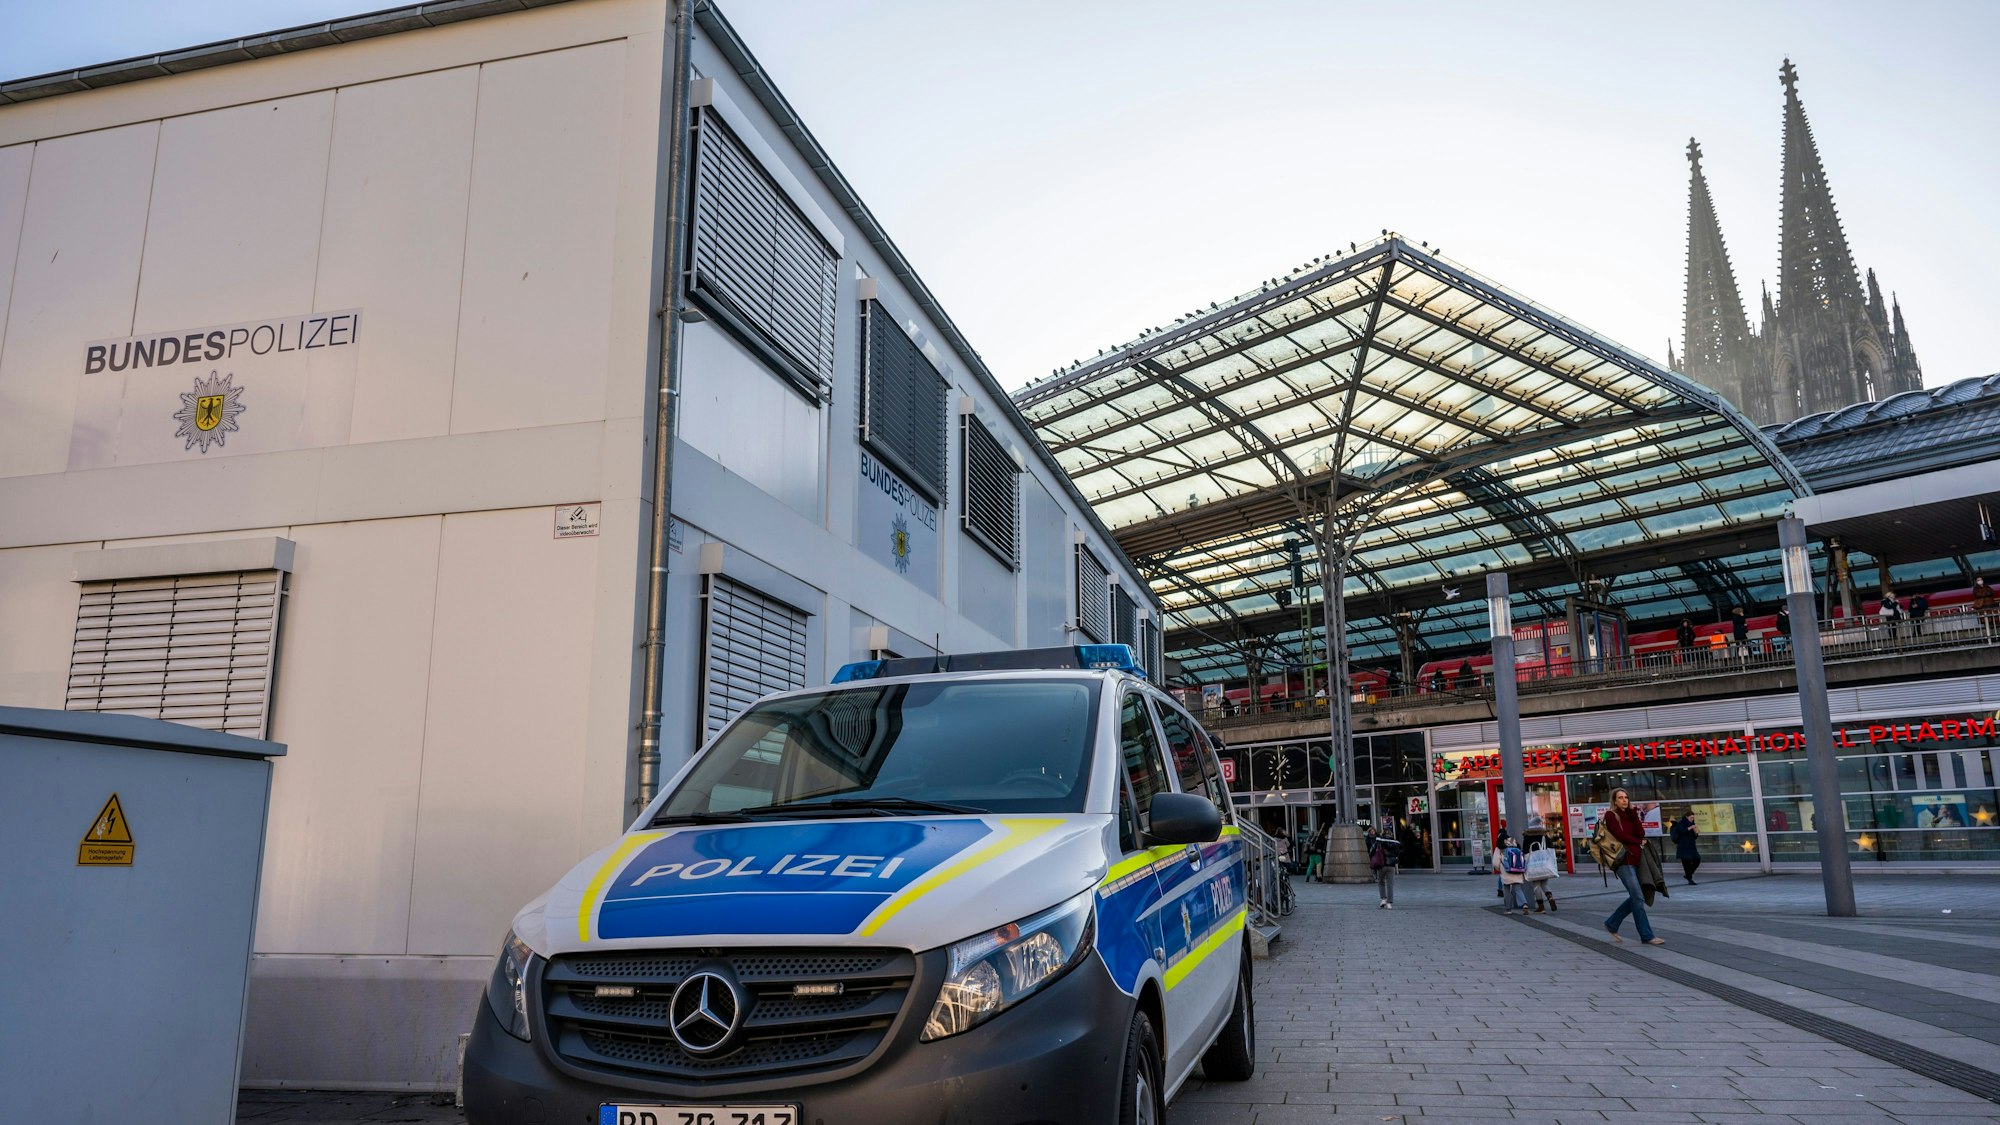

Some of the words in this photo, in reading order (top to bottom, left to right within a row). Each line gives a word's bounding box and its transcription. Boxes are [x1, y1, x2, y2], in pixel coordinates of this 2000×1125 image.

[85, 313, 358, 375] BUNDESPOLIZEI
[861, 452, 937, 533] BUNDESPOLIZEI
[1460, 747, 1579, 772] APOHEKE
[1619, 728, 1855, 762] INTERNATIONL
[1869, 717, 1996, 745] PHARM
[630, 854, 905, 887] POLIZEI
